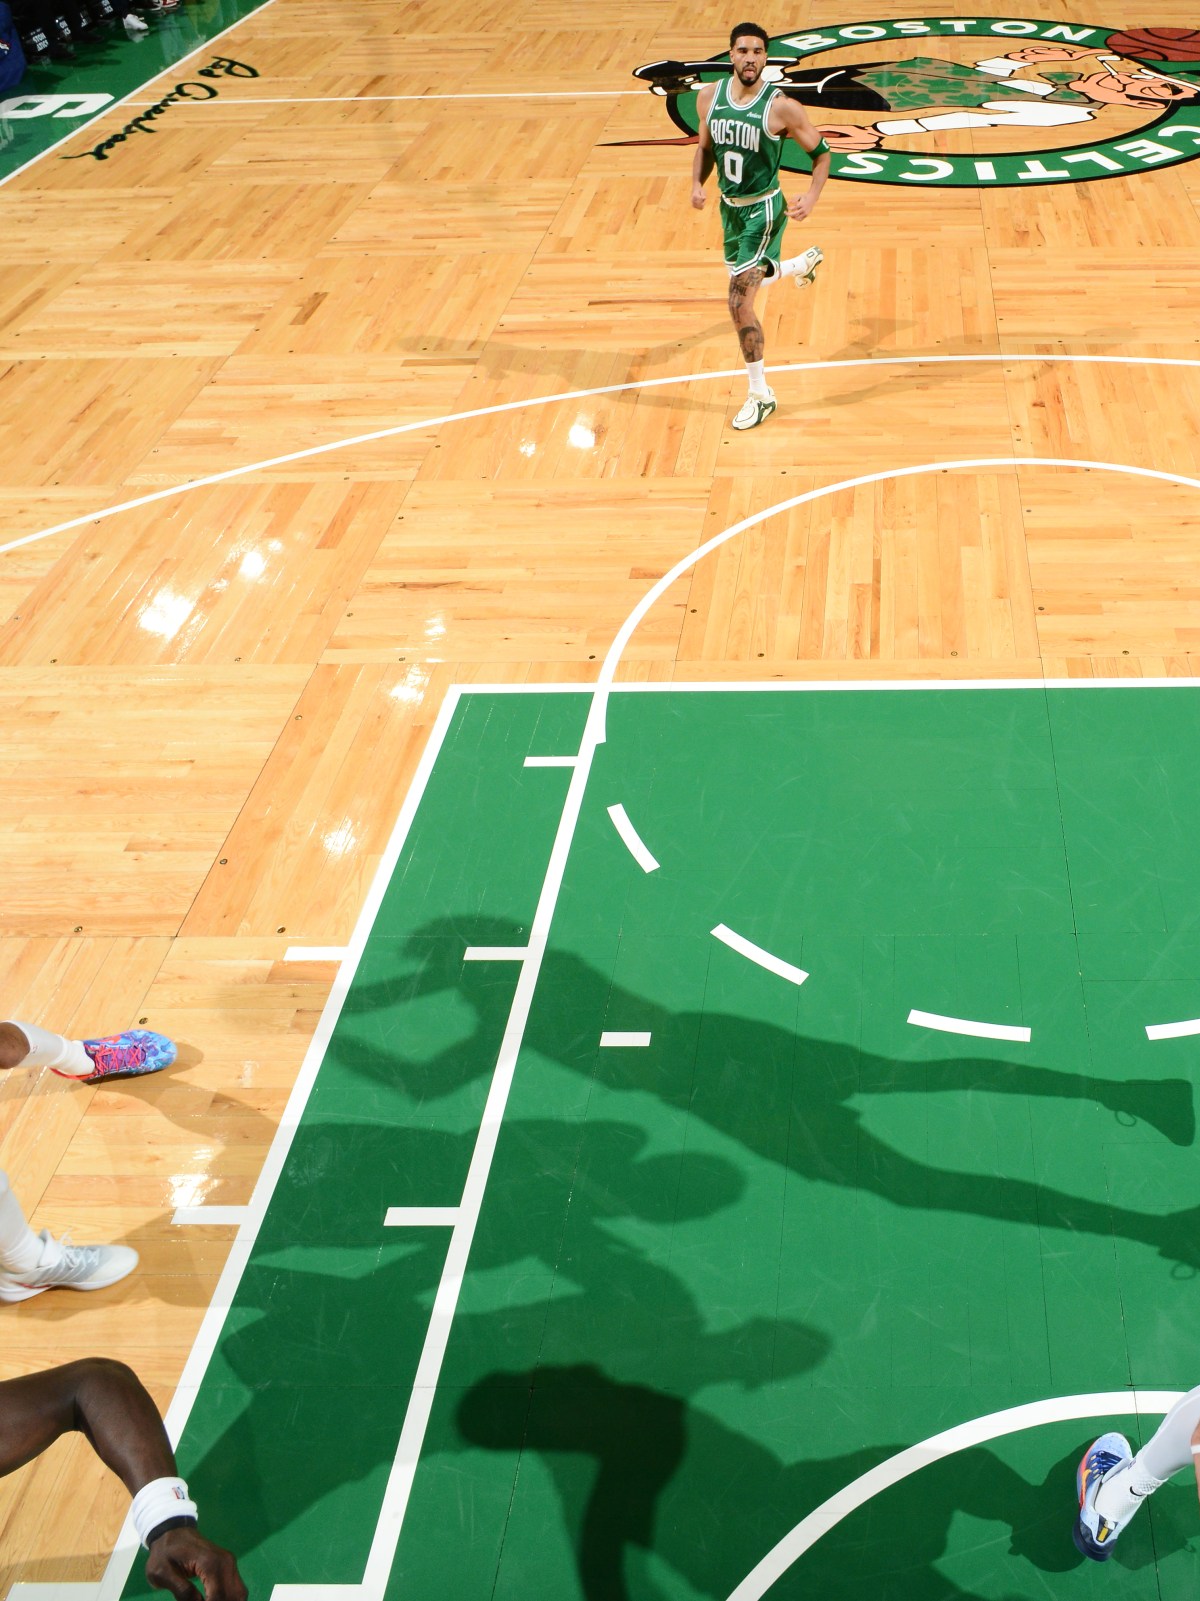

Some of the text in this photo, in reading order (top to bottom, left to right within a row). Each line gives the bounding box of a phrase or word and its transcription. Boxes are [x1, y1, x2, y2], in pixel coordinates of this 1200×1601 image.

[780, 20, 1096, 51] BOSTON
[710, 118, 760, 153] BOSTON
[724, 151, 744, 185] 0
